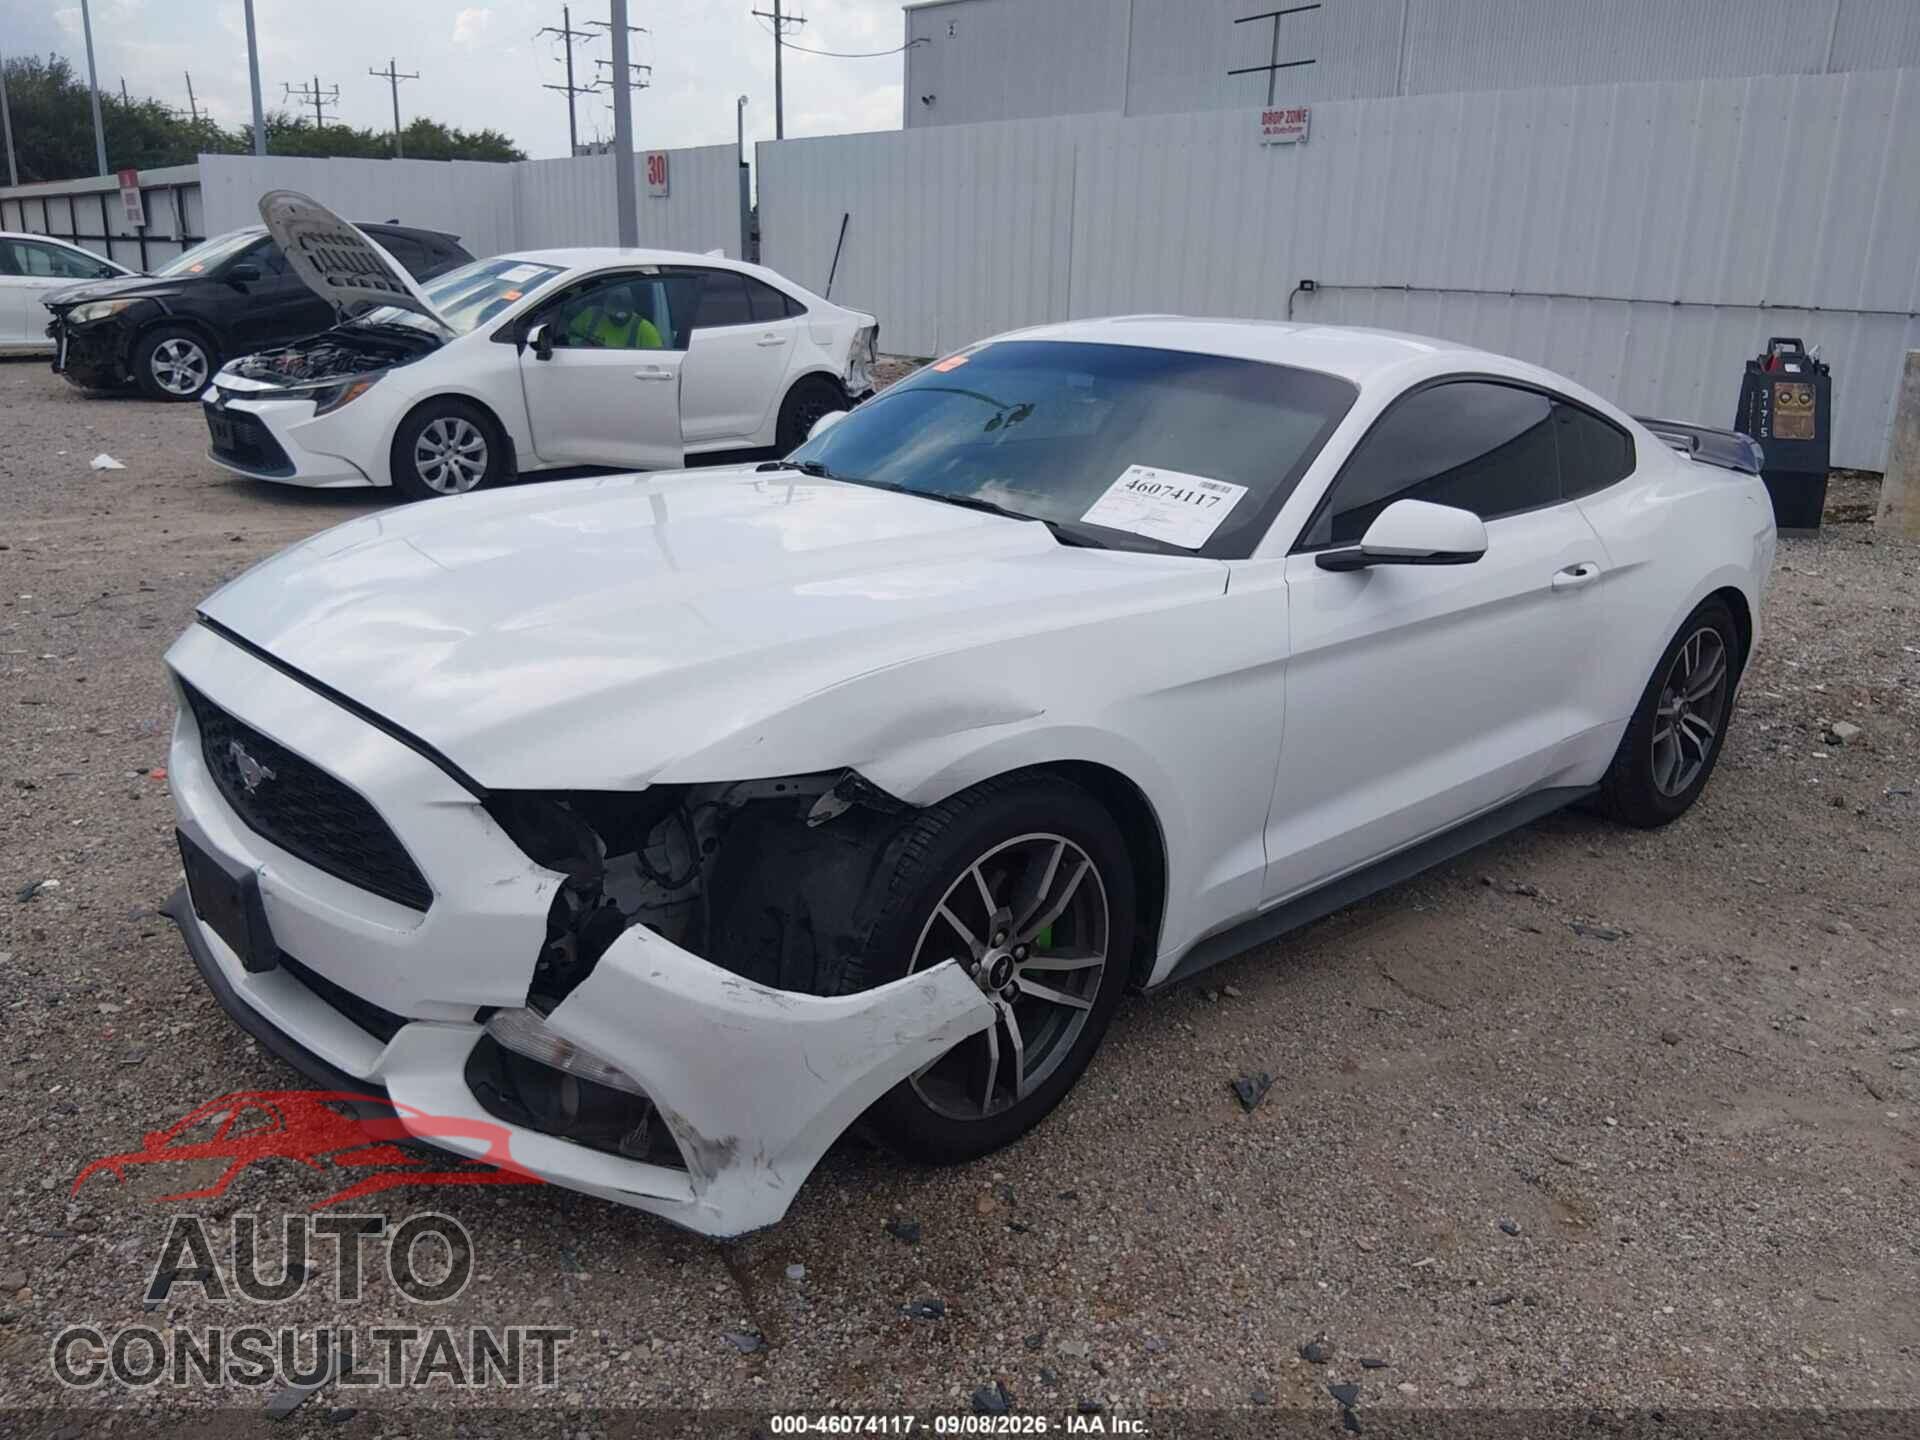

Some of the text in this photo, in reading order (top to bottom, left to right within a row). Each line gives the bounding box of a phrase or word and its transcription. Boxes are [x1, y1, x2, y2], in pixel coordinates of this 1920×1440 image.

[1286, 109, 1306, 123] ZONE
[648, 155, 664, 185] 30
[1125, 479, 1221, 509] 46074117
